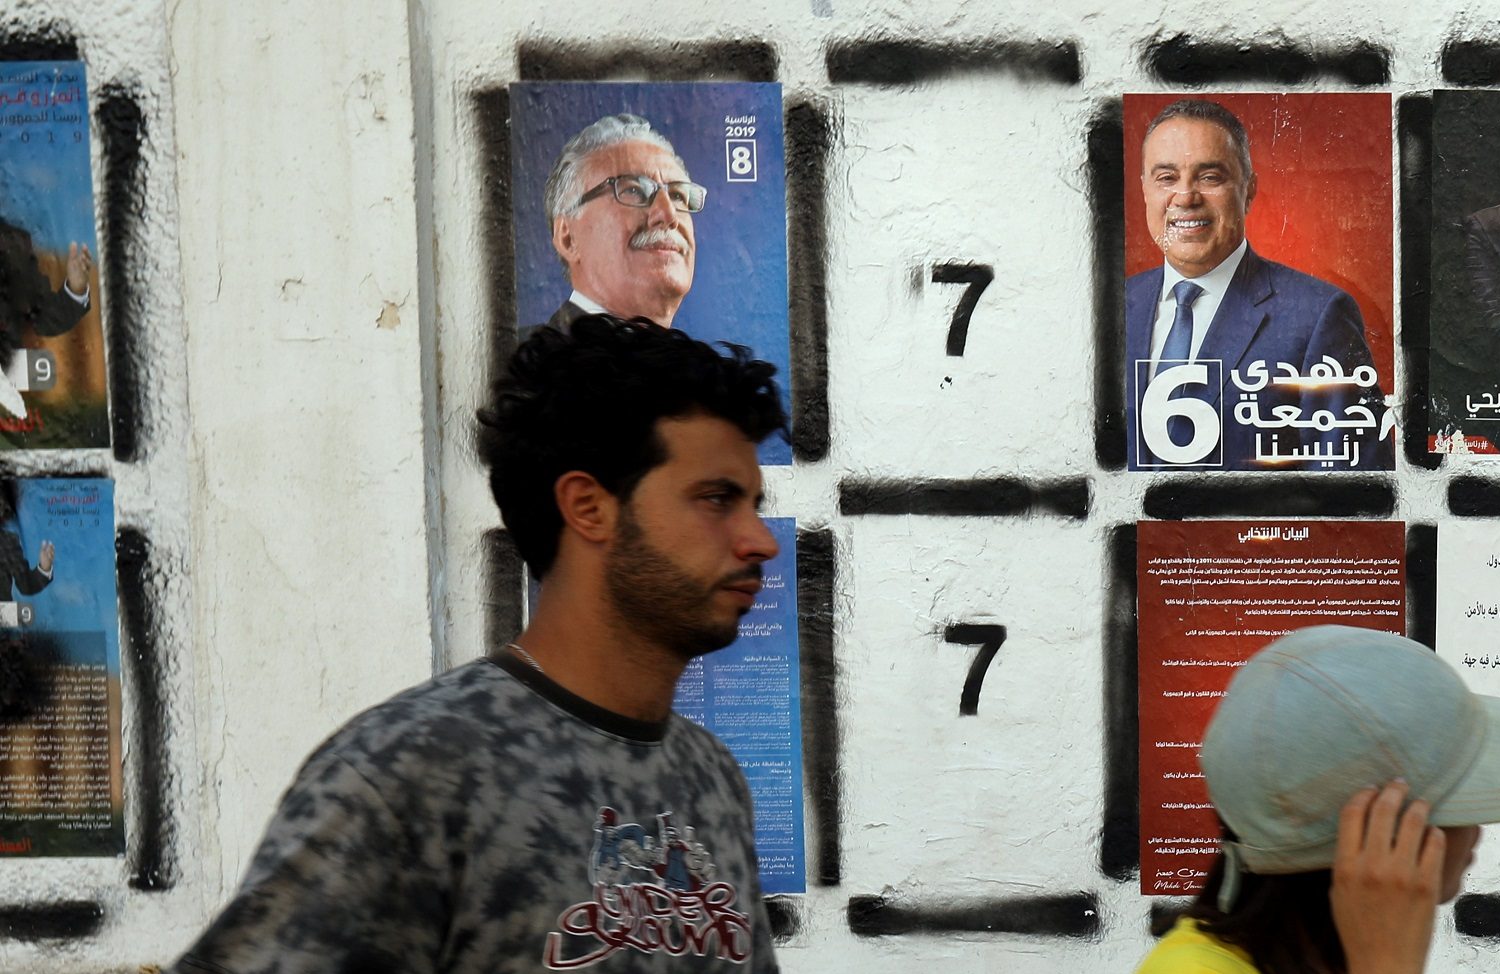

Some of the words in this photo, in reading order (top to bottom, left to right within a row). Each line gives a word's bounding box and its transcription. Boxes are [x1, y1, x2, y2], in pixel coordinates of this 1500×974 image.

[725, 115, 756, 125] الرئاسية
[726, 126, 756, 137] 2019
[731, 146, 752, 175] 8
[932, 263, 995, 356] 7
[34, 357, 51, 382] 9
[1230, 354, 1378, 392] مهدي
[1141, 364, 1220, 464] 6
[1233, 393, 1378, 434] جمعة
[1254, 432, 1361, 467] رئيسنا
[1282, 526, 1309, 541] البيان
[20, 606, 32, 622] 9
[1487, 604, 1498, 620] فيه
[945, 624, 1007, 717] 7
